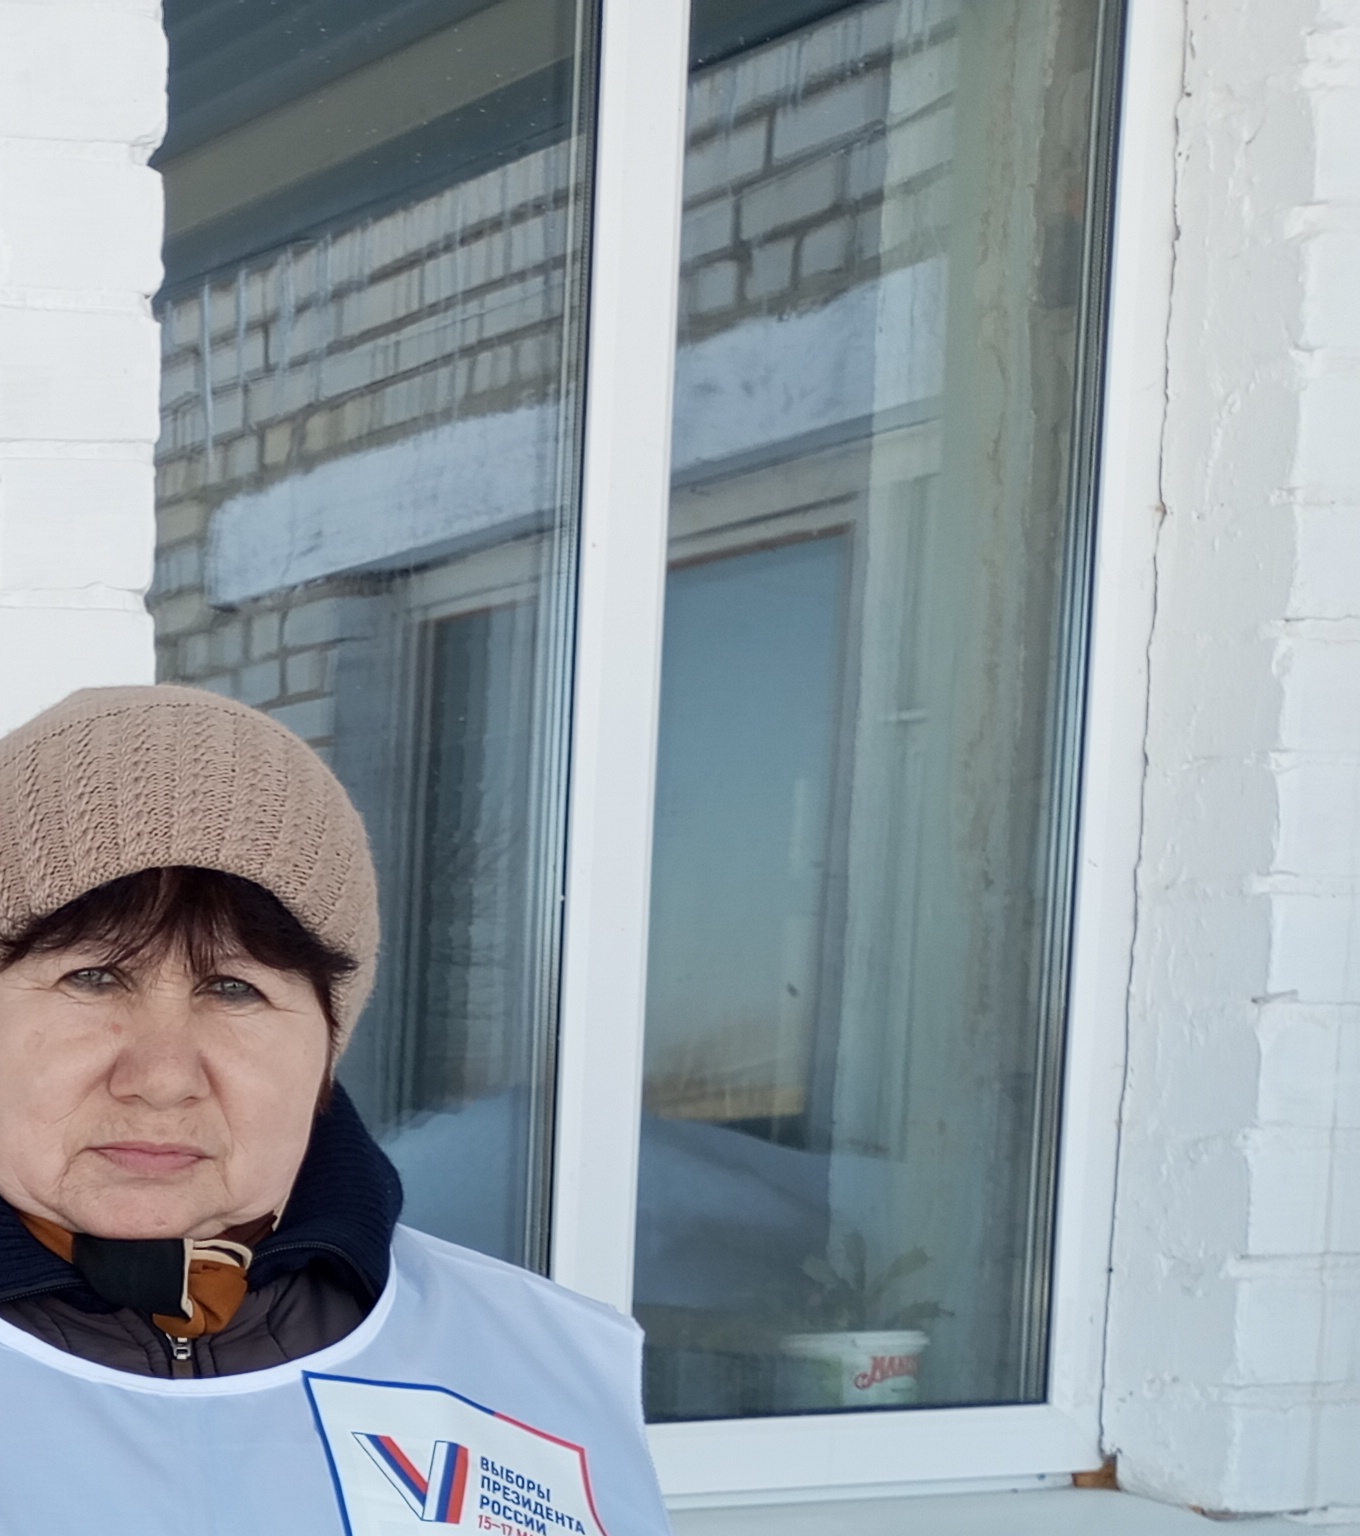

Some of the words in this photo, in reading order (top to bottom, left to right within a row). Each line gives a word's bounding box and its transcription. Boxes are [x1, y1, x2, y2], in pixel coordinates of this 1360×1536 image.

[480, 1455, 551, 1503] ВЫБОРЫ
[479, 1494, 547, 1536] РОССИИ
[480, 1474, 586, 1536] ПРЕЗИДЕНТА
